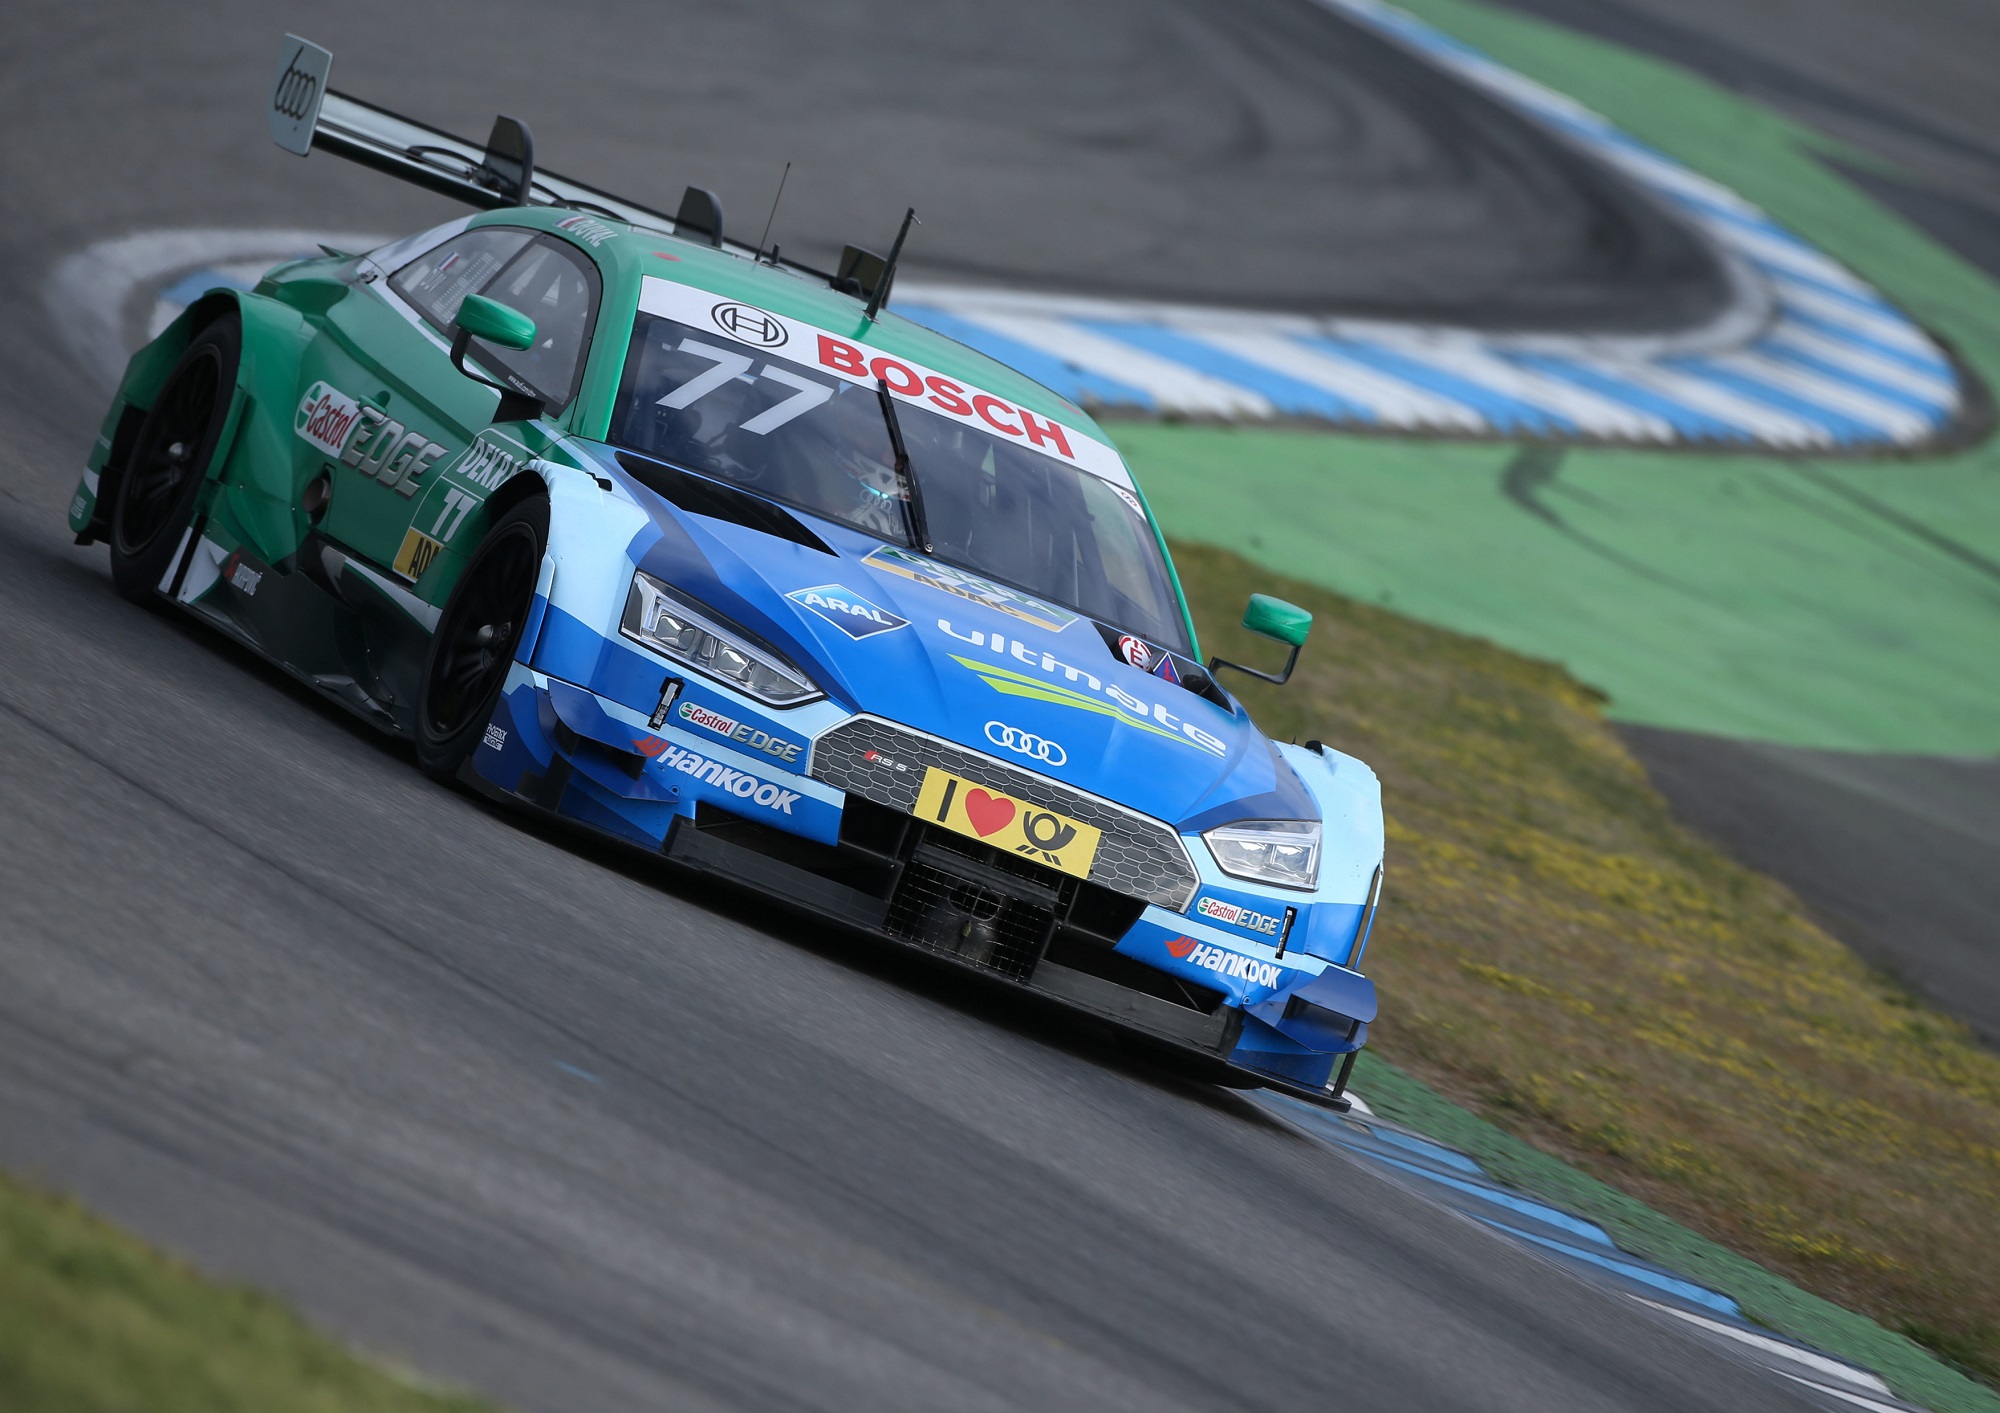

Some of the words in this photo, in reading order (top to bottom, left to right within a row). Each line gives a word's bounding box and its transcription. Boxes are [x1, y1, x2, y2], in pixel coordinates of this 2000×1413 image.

[655, 338, 835, 436] 77
[816, 333, 1076, 460] BOSCH
[306, 394, 362, 449] Castrol
[341, 417, 450, 498] EDGE
[804, 592, 893, 626] ARAL
[892, 549, 1062, 619] DEKRA
[913, 572, 1020, 618] ADAC
[937, 618, 1227, 758] ultimate
[690, 707, 734, 735] Castrol
[730, 723, 803, 764] EDGE
[870, 753, 894, 767] RS
[895, 762, 908, 773] 5
[936, 778, 958, 823] I
[1207, 901, 1238, 922] Castrol
[1236, 909, 1281, 936] EDGE
